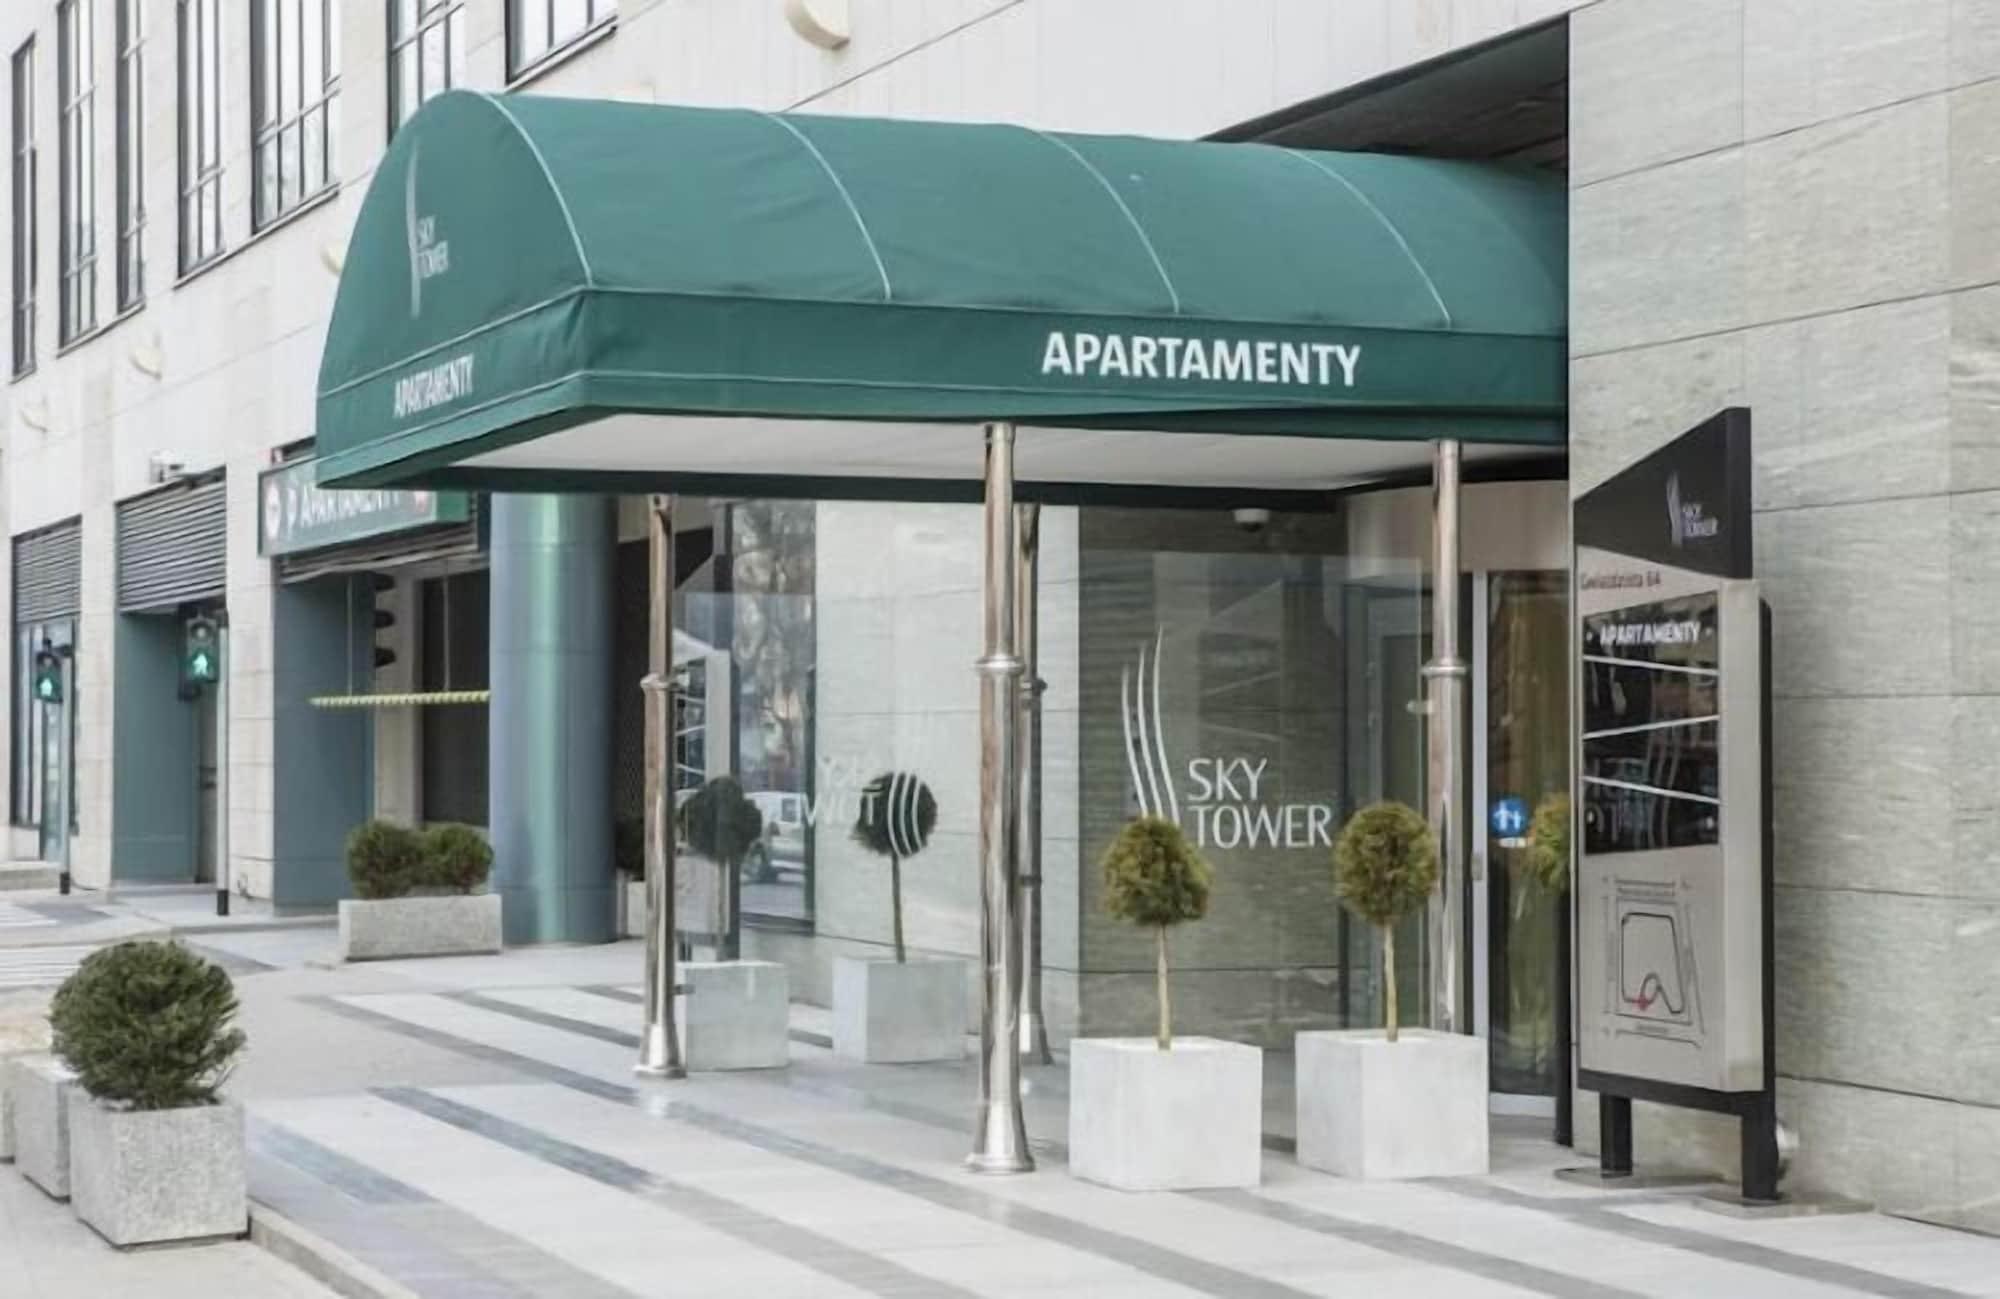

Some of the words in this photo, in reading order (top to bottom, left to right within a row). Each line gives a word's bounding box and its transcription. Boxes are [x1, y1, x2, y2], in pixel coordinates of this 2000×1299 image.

[1041, 331, 1361, 387] APARTAMENTY
[393, 353, 475, 419] APARTAMENTY
[1600, 621, 1701, 645] APARTAMENTY
[1186, 757, 1268, 801] SKY
[1187, 803, 1332, 849] TOWER
